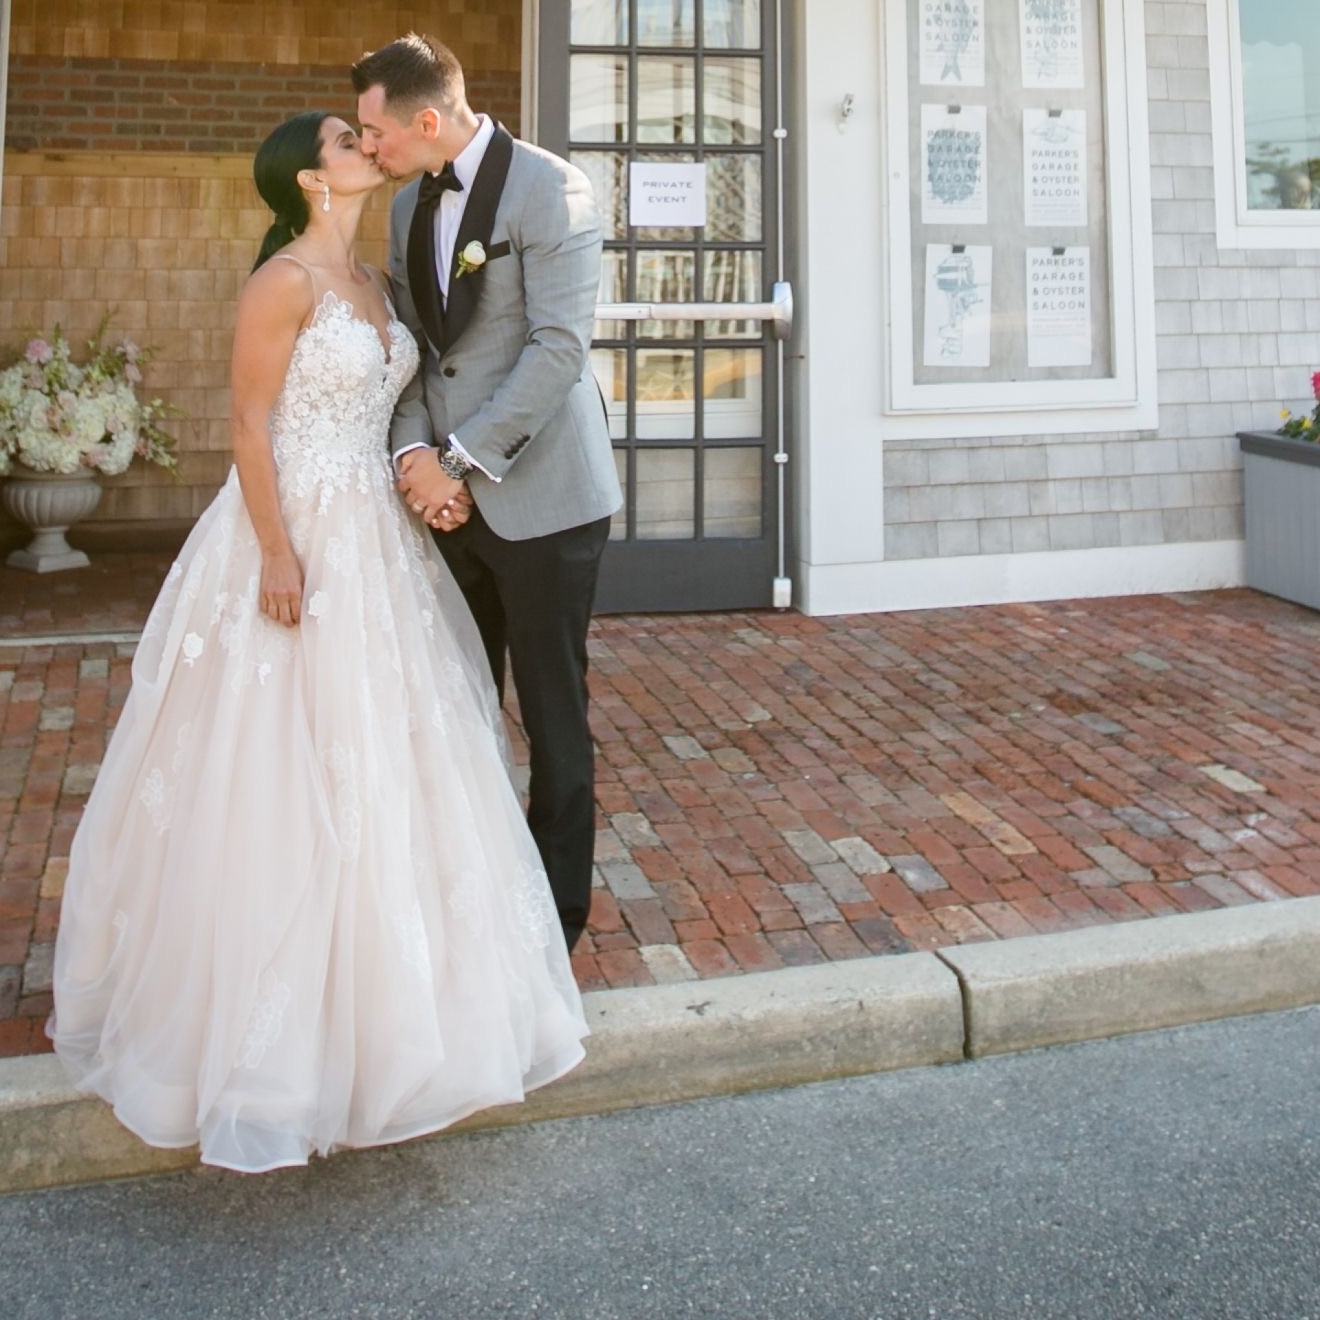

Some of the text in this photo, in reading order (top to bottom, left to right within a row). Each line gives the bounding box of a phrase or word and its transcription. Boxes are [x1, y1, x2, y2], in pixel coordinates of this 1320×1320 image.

[642, 181, 694, 189] PRIVATE
[1032, 188, 1080, 197] SALOON
[1032, 272, 1085, 281] GARAGE
[1043, 286, 1085, 296] OYSTER
[1032, 301, 1085, 310] SALOON
